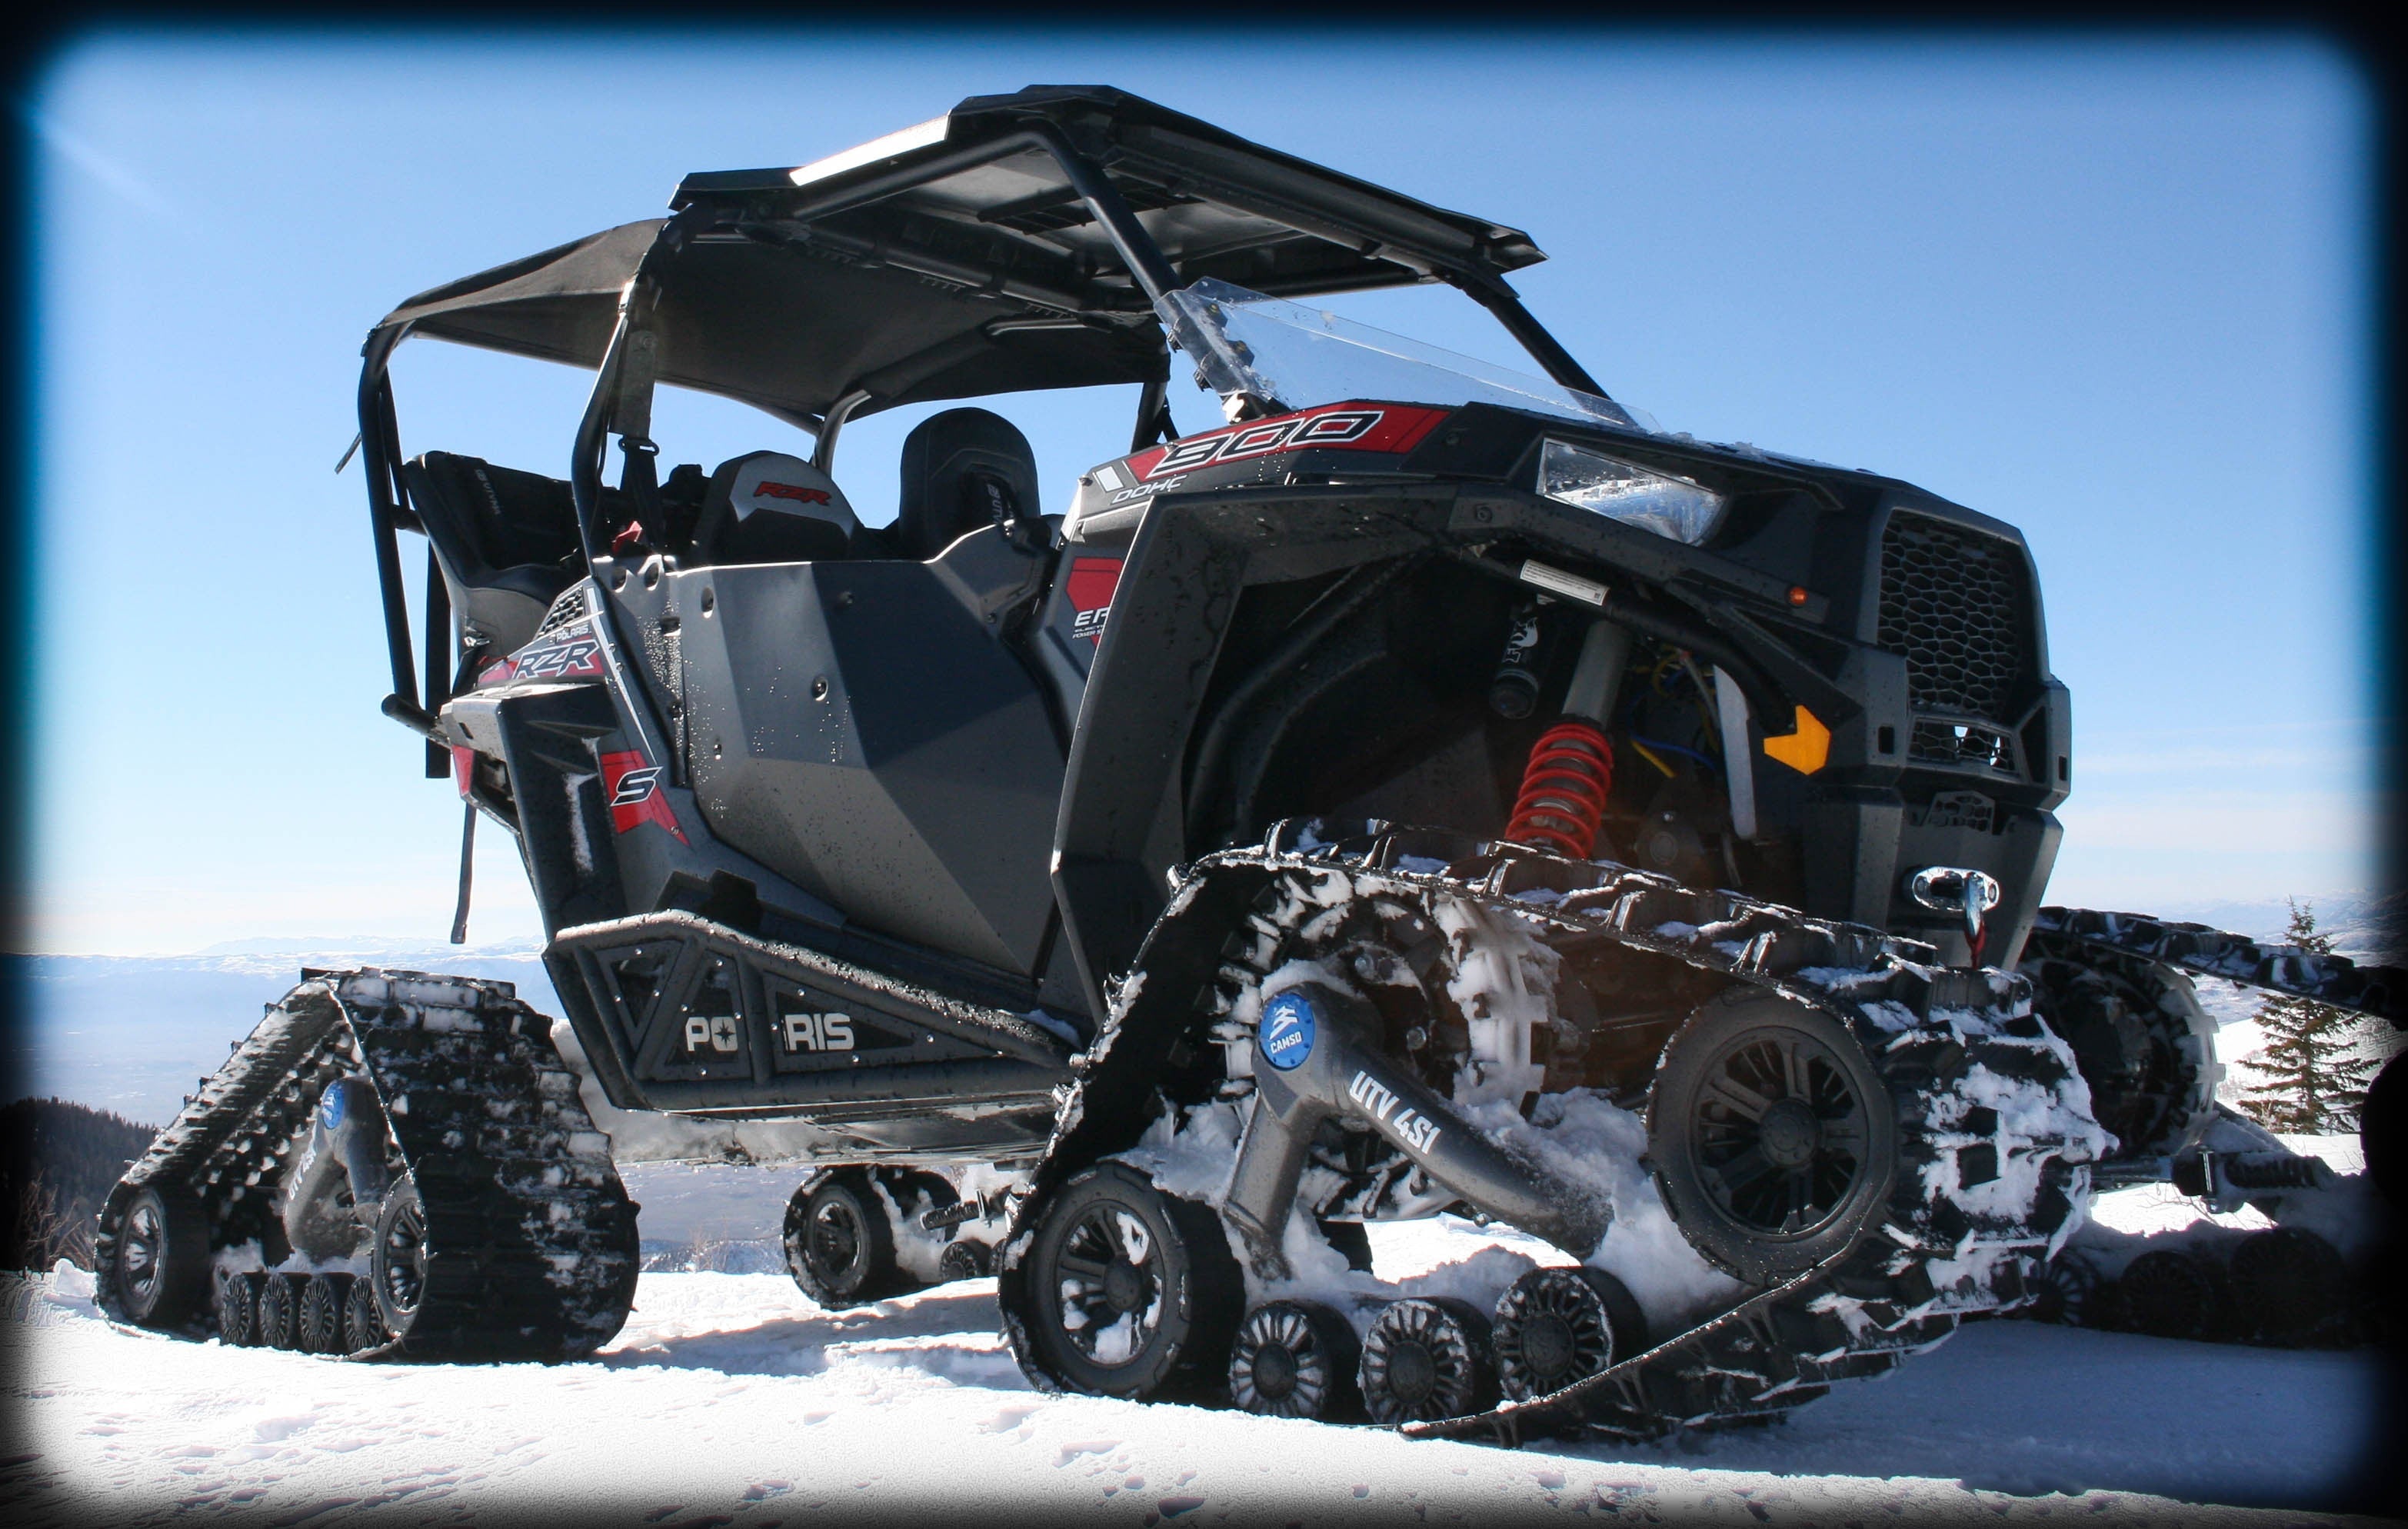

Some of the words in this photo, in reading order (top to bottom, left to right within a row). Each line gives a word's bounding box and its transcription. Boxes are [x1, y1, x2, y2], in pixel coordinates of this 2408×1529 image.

[1145, 411, 1384, 478] 900
[1111, 475, 1187, 504] DOHC
[556, 624, 590, 641] POLARIS
[512, 639, 600, 679] RZR
[610, 766, 664, 807] S
[1270, 1031, 1302, 1054] CAMSO
[1349, 1071, 1400, 1120] UTV
